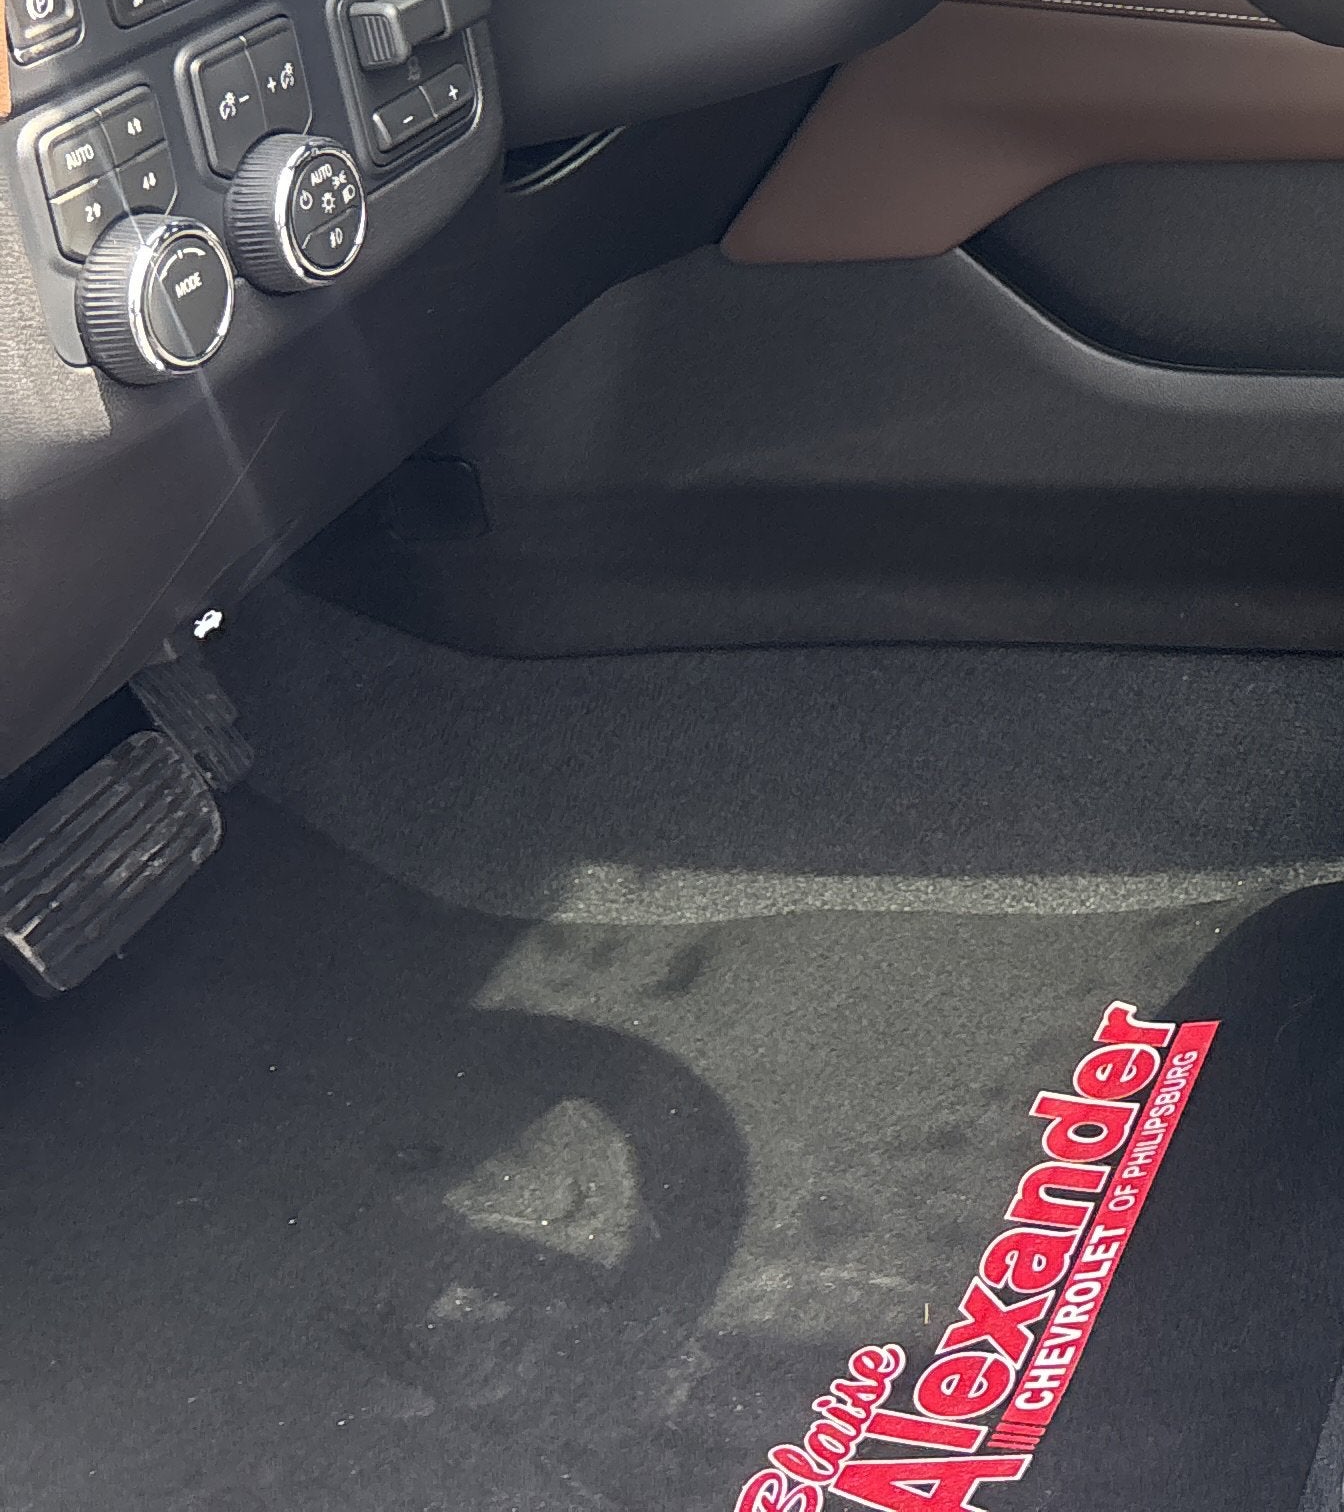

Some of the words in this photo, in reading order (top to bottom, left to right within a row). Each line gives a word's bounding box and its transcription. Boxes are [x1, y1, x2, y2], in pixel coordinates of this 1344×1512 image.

[64, 143, 95, 171] AUTO
[310, 163, 333, 187] AUTO
[175, 271, 203, 299] MODE
[1121, 1049, 1200, 1180] PHILIPSBURG
[1107, 1183, 1142, 1213] OF
[828, 999, 1177, 1512] Alexander
[1013, 1223, 1128, 1412] CHEVROLET
